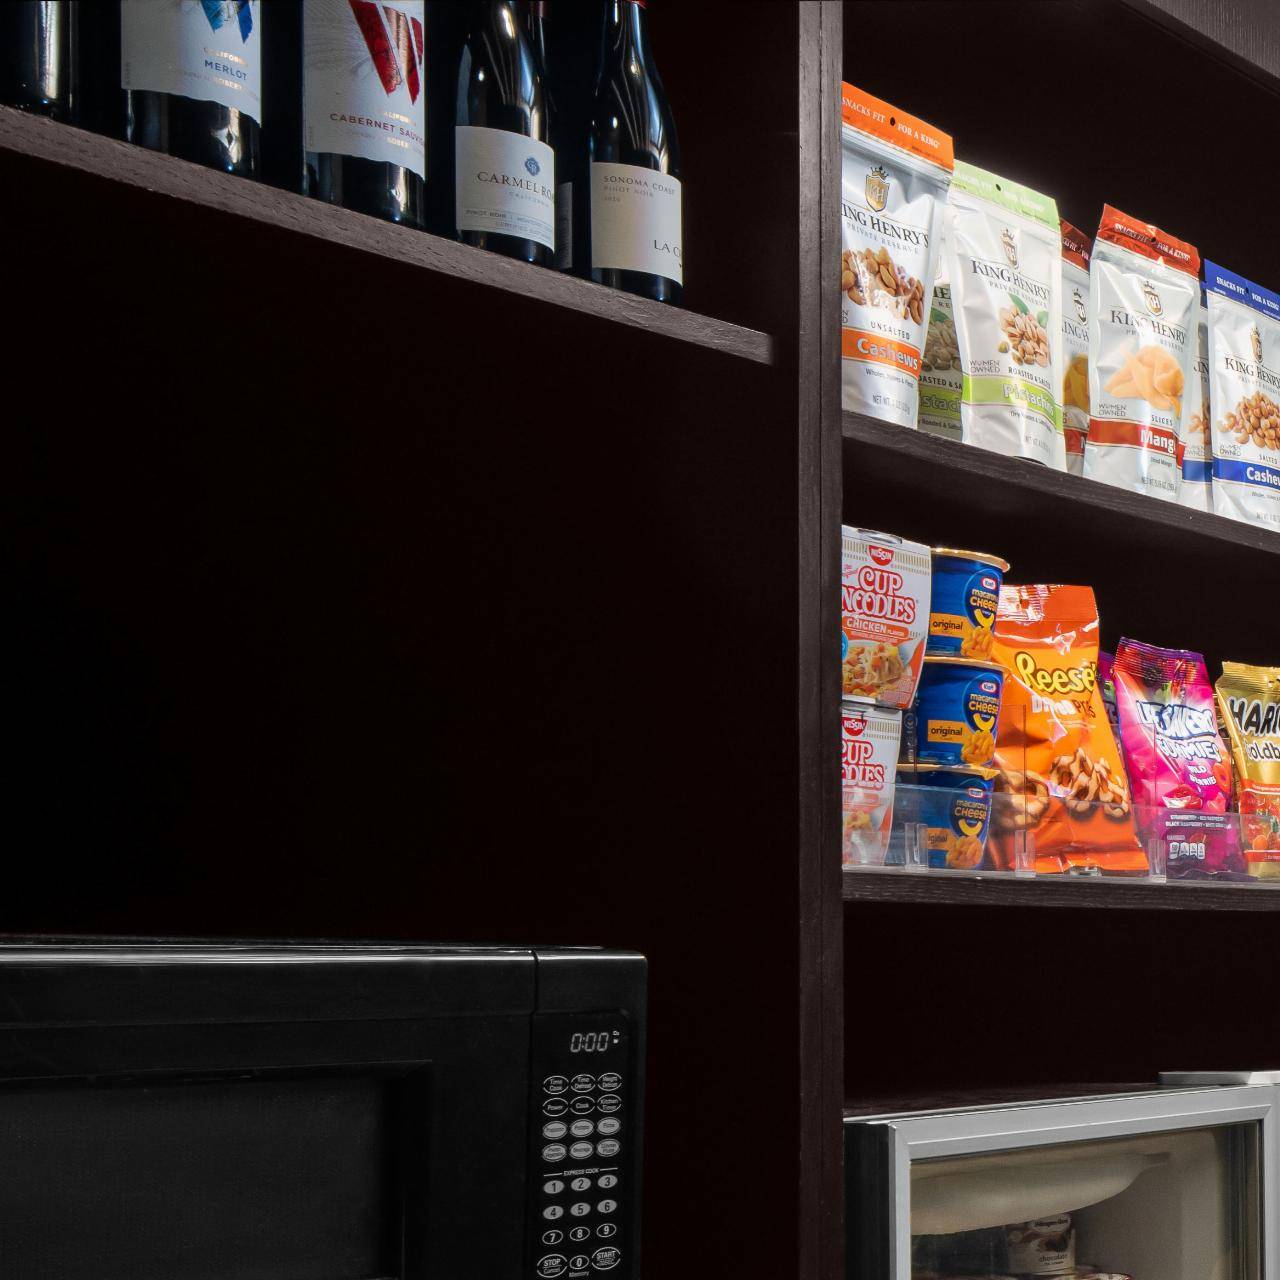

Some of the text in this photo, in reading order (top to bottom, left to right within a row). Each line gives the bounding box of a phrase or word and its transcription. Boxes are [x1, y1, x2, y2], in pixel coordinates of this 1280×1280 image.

[204, 59, 247, 81] MERLOT
[330, 112, 395, 133] CABERNET
[842, 97, 939, 148] SNACKS FIT FOR A KING
[477, 171, 539, 193] CARMEL
[604, 175, 675, 195] SONOMA COAST
[970, 260, 1011, 284] KING
[1216, 276, 1235, 292] SNACKS
[1236, 284, 1245, 295] FIT
[1251, 292, 1262, 304] FOR
[870, 321, 910, 340] UNSALTED
[857, 338, 918, 370] Cashews
[1225, 357, 1254, 376] KING
[1151, 414, 1173, 427] SLICES
[857, 566, 903, 594] CUP
[841, 585, 916, 624] NOODLES
[846, 619, 887, 636] CHICKEN
[932, 619, 963, 632] original
[930, 727, 963, 738] original
[551, 1182, 557, 1193] 1
[578, 1178, 584, 1189] 2
[605, 1176, 611, 1187] 3
[550, 1207, 556, 1218] 4
[577, 1204, 584, 1215] 5
[604, 1201, 610, 1212] 6
[577, 1229, 583, 1239] 8
[603, 1225, 610, 1235] 9
[549, 1233, 556, 1243] 7
[596, 1250, 616, 1260] START
[543, 1258, 561, 1267] STOP
[576, 1257, 582, 1267] 0
